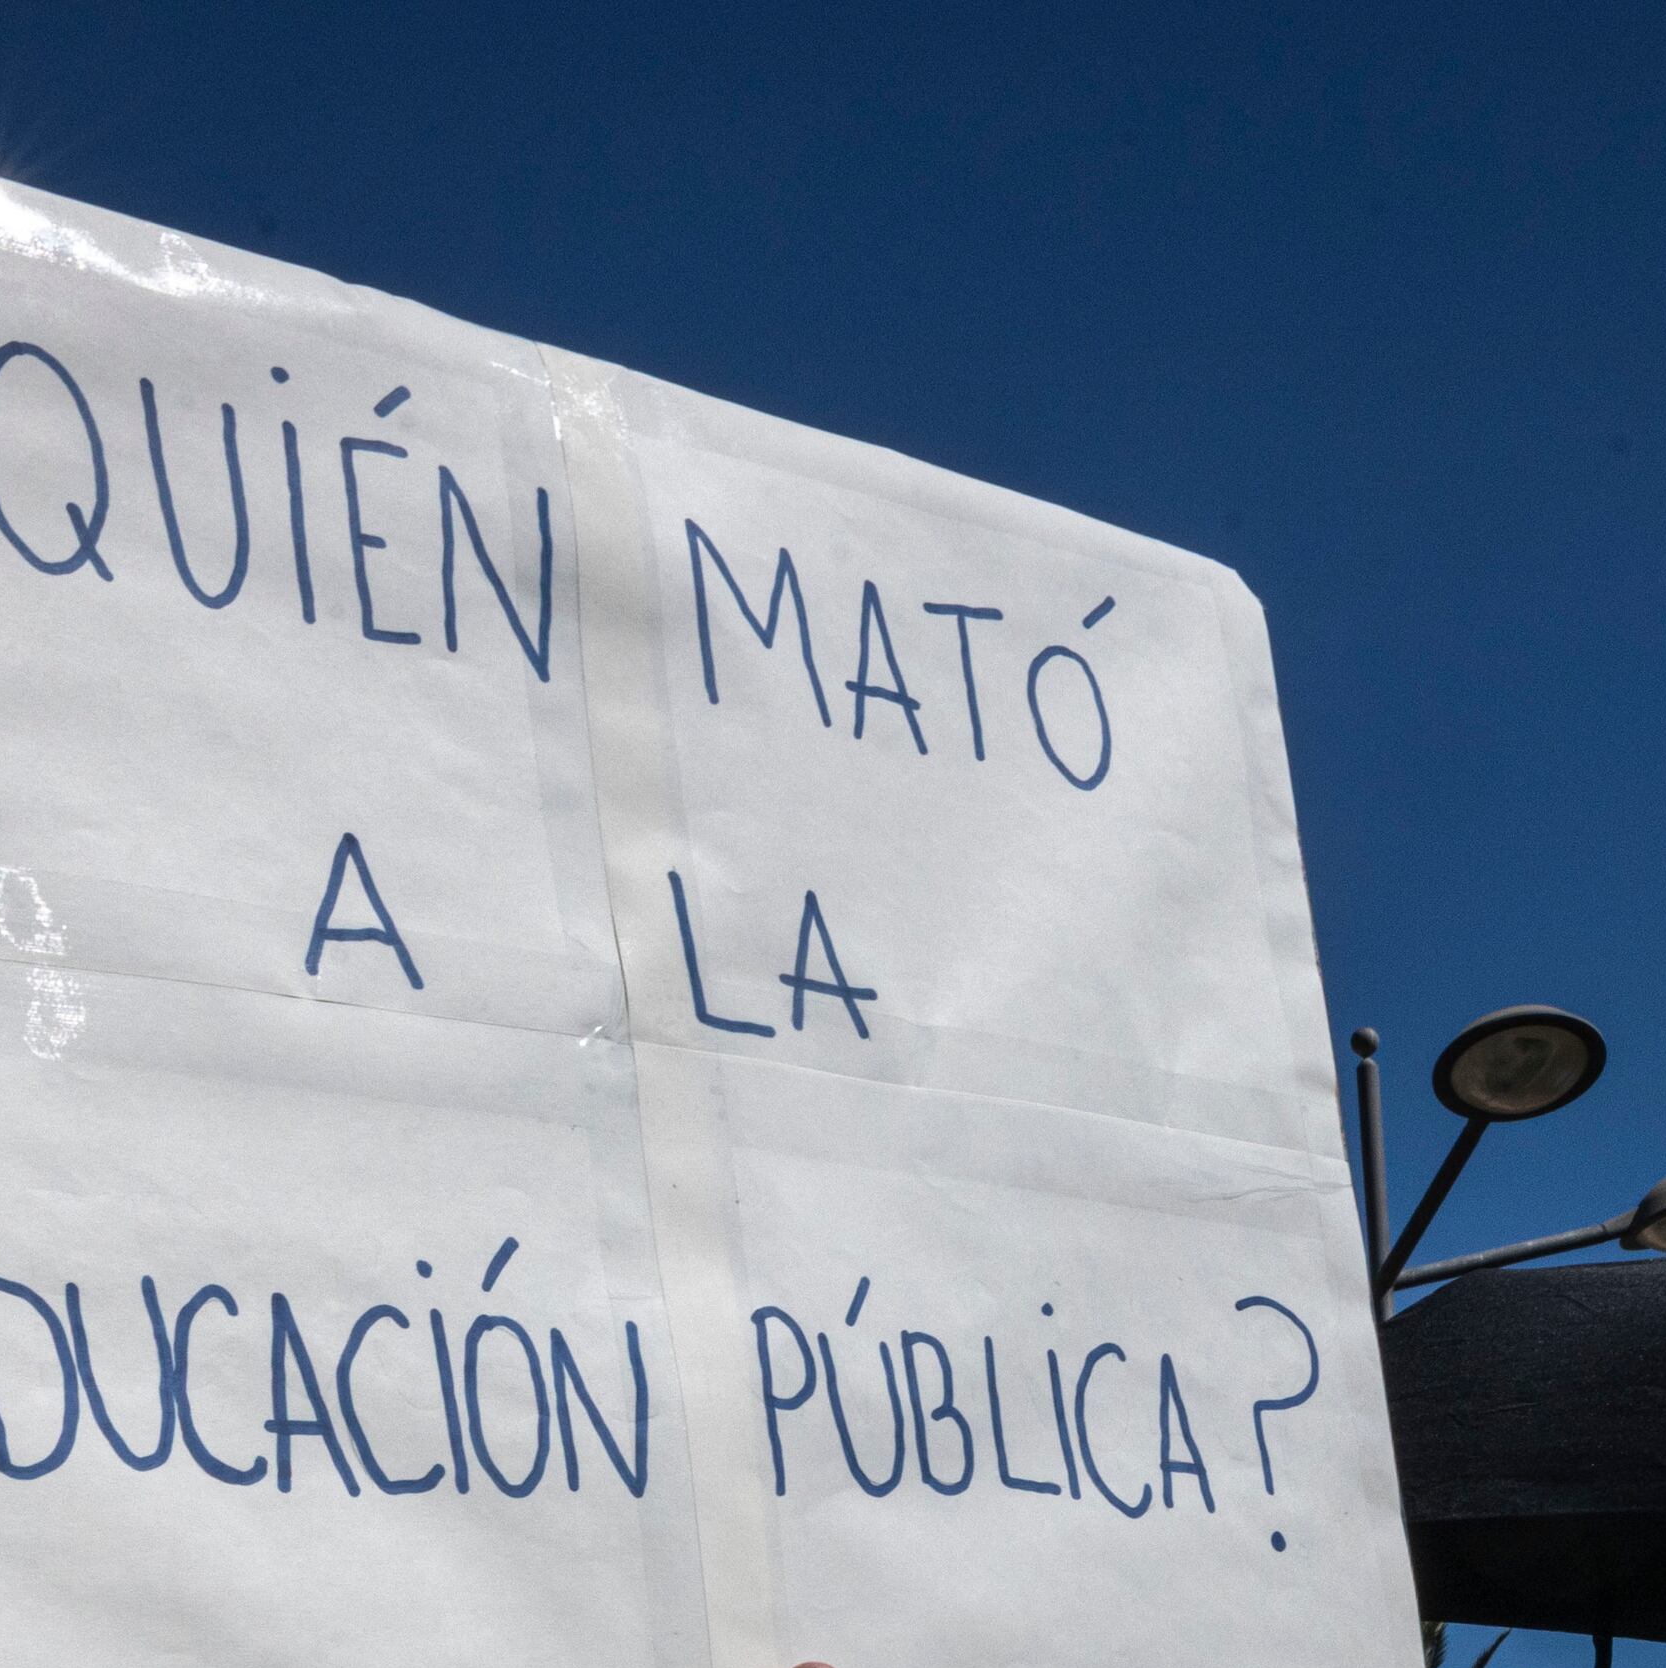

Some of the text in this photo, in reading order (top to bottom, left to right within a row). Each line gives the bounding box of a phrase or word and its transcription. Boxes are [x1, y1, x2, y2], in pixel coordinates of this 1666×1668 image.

[685, 516, 1117, 792] MATÓ
[305, 832, 878, 1040] A LA
[750, 1276, 1320, 1553] PÚBLICA?
